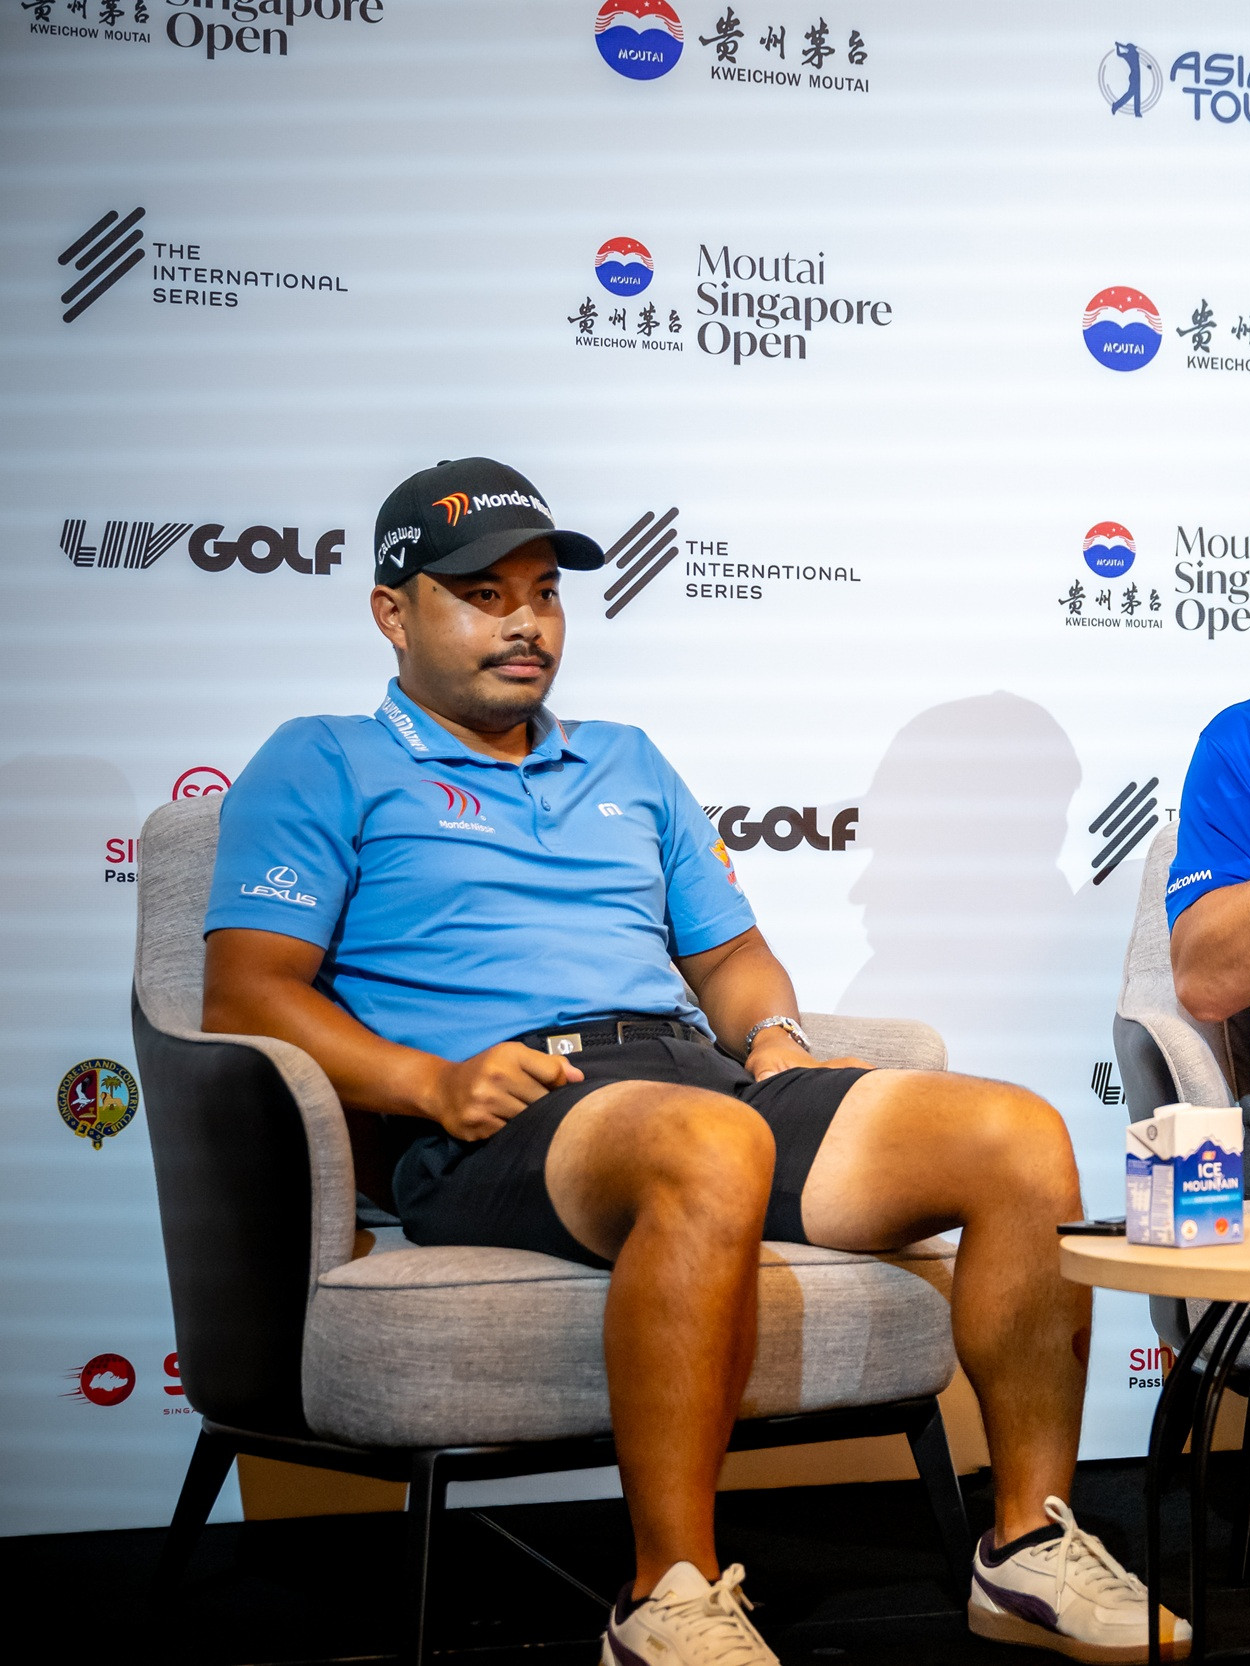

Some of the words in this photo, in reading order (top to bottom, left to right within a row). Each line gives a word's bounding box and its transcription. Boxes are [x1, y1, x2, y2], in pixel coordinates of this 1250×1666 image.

[30, 23, 99, 39] KWEICHOW
[104, 29, 151, 43] MOUTAI
[166, 12, 288, 60] Open
[618, 48, 664, 63] MOUTAI
[711, 66, 801, 87] KWEICHOW
[809, 74, 869, 93] MOUTAI
[153, 243, 201, 260] THE
[697, 243, 824, 285] Moutai
[153, 264, 348, 292] INTERNATIONAL
[610, 275, 641, 285] MOUTAI
[153, 288, 239, 308] SERIES
[697, 281, 893, 331] Singapore
[575, 336, 637, 349] KWEICHOW
[642, 340, 683, 352] MOUTAI
[697, 321, 806, 366] Open
[1103, 342, 1144, 355] MOUTAI
[473, 490, 531, 512] Monde
[59, 519, 194, 569] LIV
[188, 523, 345, 575] GOLF
[378, 526, 421, 565] Callaway
[685, 541, 729, 556] THE
[686, 561, 861, 582] INTERNATIONAL
[1096, 558, 1124, 567] MOUTAI
[686, 583, 763, 600] SERIES
[1065, 616, 1121, 628] KWEICHOW
[1125, 618, 1162, 629] MOUTAI
[439, 819, 471, 831] Monde
[718, 805, 859, 852] GOLF
[105, 838, 140, 863] SI
[241, 884, 317, 907] LEXUS
[58, 1068, 80, 1122] SINGAPORE
[80, 1060, 116, 1071] ISLAND
[118, 1068, 138, 1111] COUNTRY
[1197, 1162, 1222, 1178] ICE
[1183, 1177, 1239, 1193] MOUNTAIN
